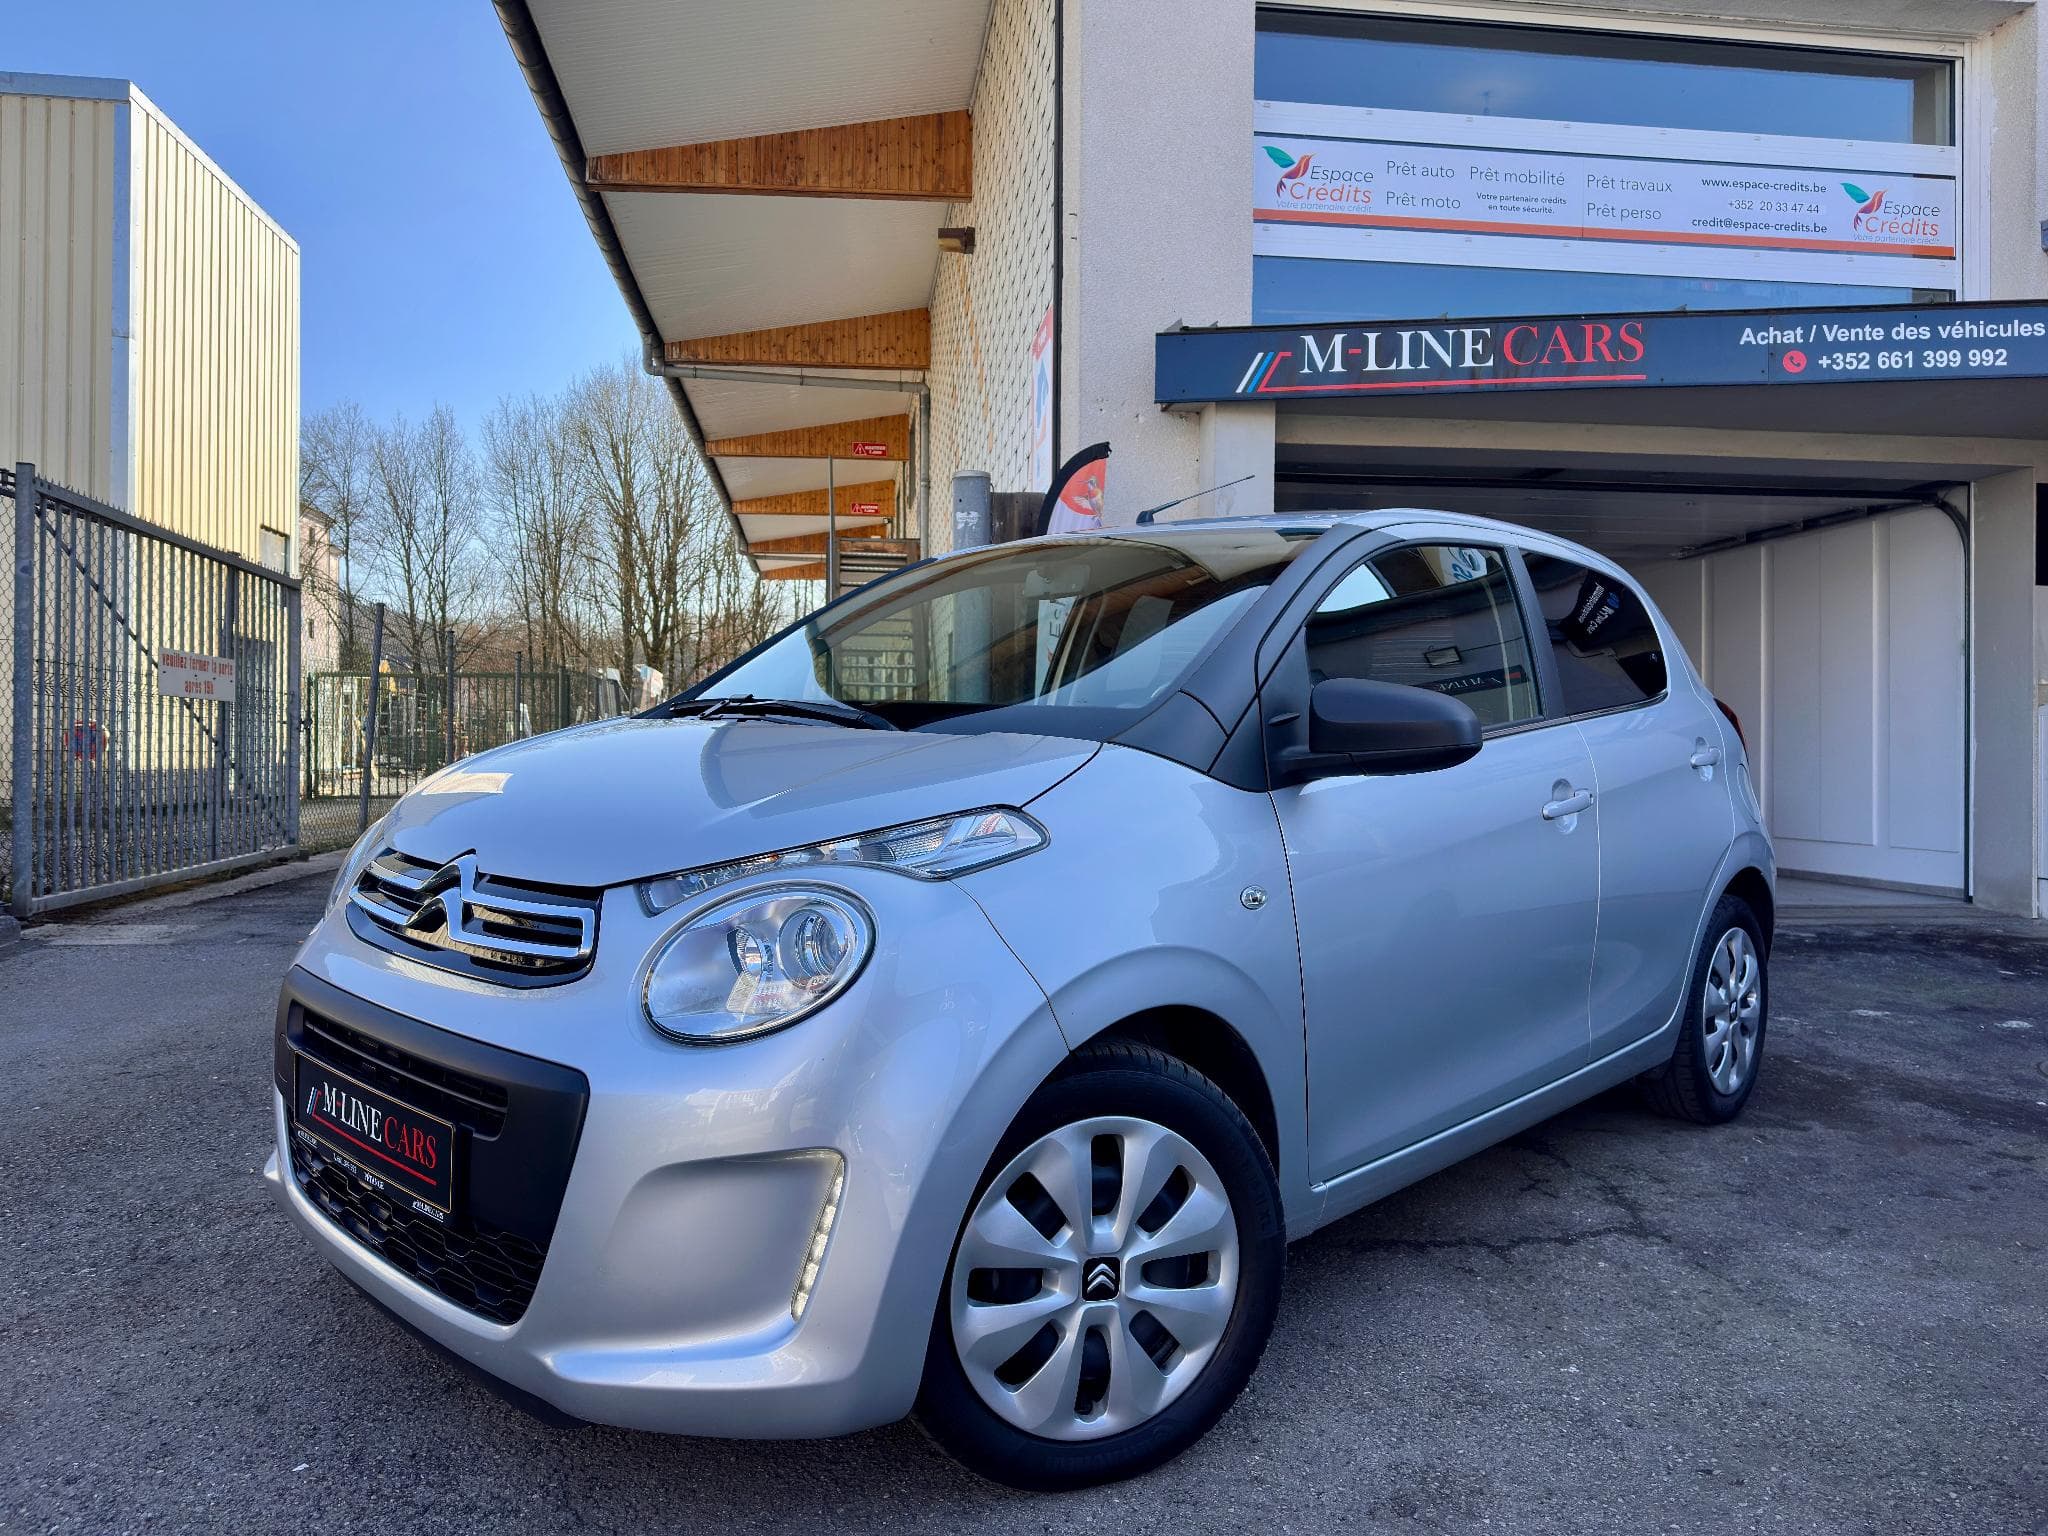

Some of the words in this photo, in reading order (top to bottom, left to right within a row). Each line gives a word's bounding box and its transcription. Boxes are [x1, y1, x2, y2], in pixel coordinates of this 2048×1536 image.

[1310, 165, 1374, 183] Espace
[1387, 160, 1417, 176] Prêt
[1421, 165, 1455, 178] auto
[1470, 166, 1500, 182] Prêt
[1504, 169, 1565, 186] mobilité
[1587, 174, 1616, 190] Prêt
[1620, 177, 1673, 193] travaux
[1701, 178, 1827, 193] www.espace-credits.be
[1290, 182, 1372, 204] Crédits
[1386, 191, 1416, 207] Prêt
[1421, 197, 1461, 209] moto
[1476, 192, 1498, 201] Votre
[1499, 194, 1539, 204] partenaire
[1300, 201, 1346, 213] partenaire
[1500, 204, 1521, 212] toute
[1587, 202, 1616, 218] Prêt
[1620, 208, 1662, 223] perso
[1728, 200, 1754, 211] +352
[1759, 200, 1773, 212] 20
[1775, 202, 1788, 213] 33
[1791, 203, 1804, 213] 47
[1806, 204, 1819, 214] 44
[1883, 200, 1941, 218] Espace
[1691, 217, 1828, 233] credit@espace-credits.be
[1865, 217, 1940, 237] Crédits
[1739, 326, 1804, 346] Achat
[1822, 324, 1885, 342] Vente
[1891, 322, 1931, 341] des
[1937, 319, 2046, 340] véhicules
[1299, 327, 1494, 374] M-LINE
[1503, 322, 1646, 366] CARS
[1818, 352, 1870, 371] +352
[1877, 350, 1914, 369] 661
[1922, 349, 1962, 368] 399
[1968, 348, 2008, 367] 992
[323, 1081, 382, 1143] M-LINE
[384, 1116, 438, 1170] CARS
